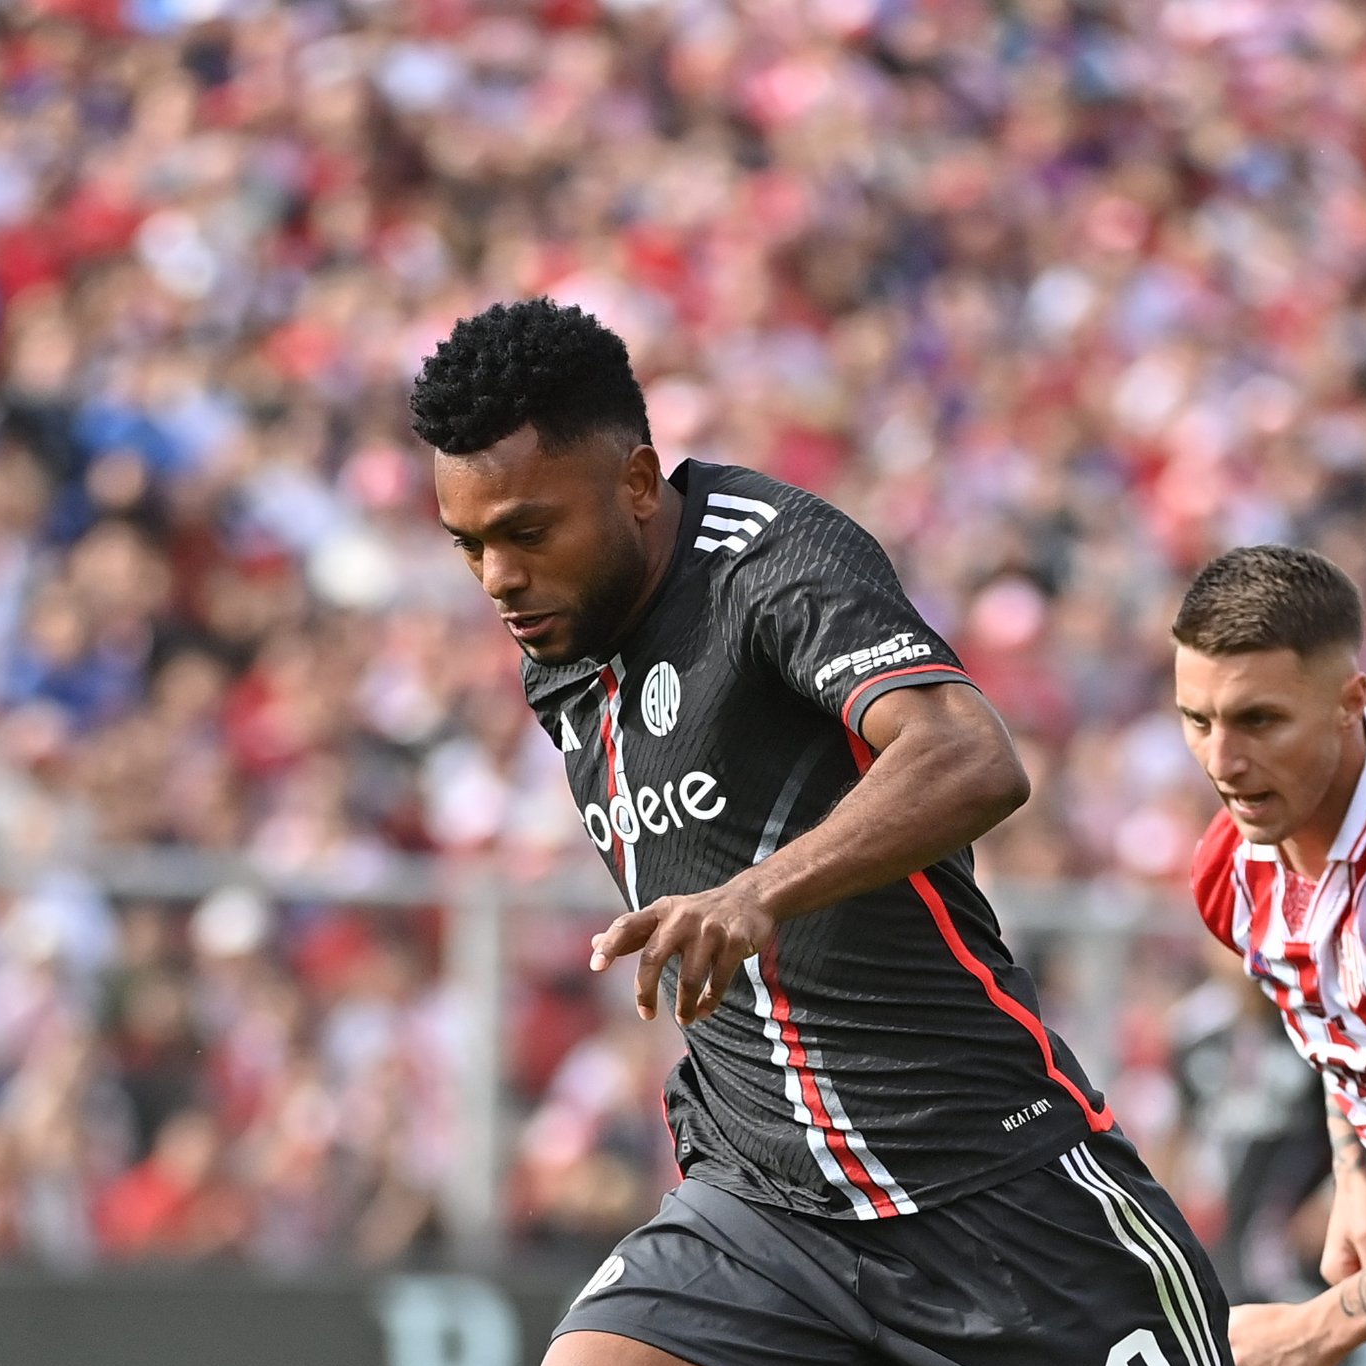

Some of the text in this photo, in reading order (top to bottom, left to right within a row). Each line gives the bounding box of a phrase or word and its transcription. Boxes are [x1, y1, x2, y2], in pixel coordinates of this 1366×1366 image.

[814, 632, 914, 691] ASSIST
[853, 643, 932, 676] CARD
[580, 770, 727, 852] odere
[1001, 1098, 1053, 1132] HEAT.RDY
